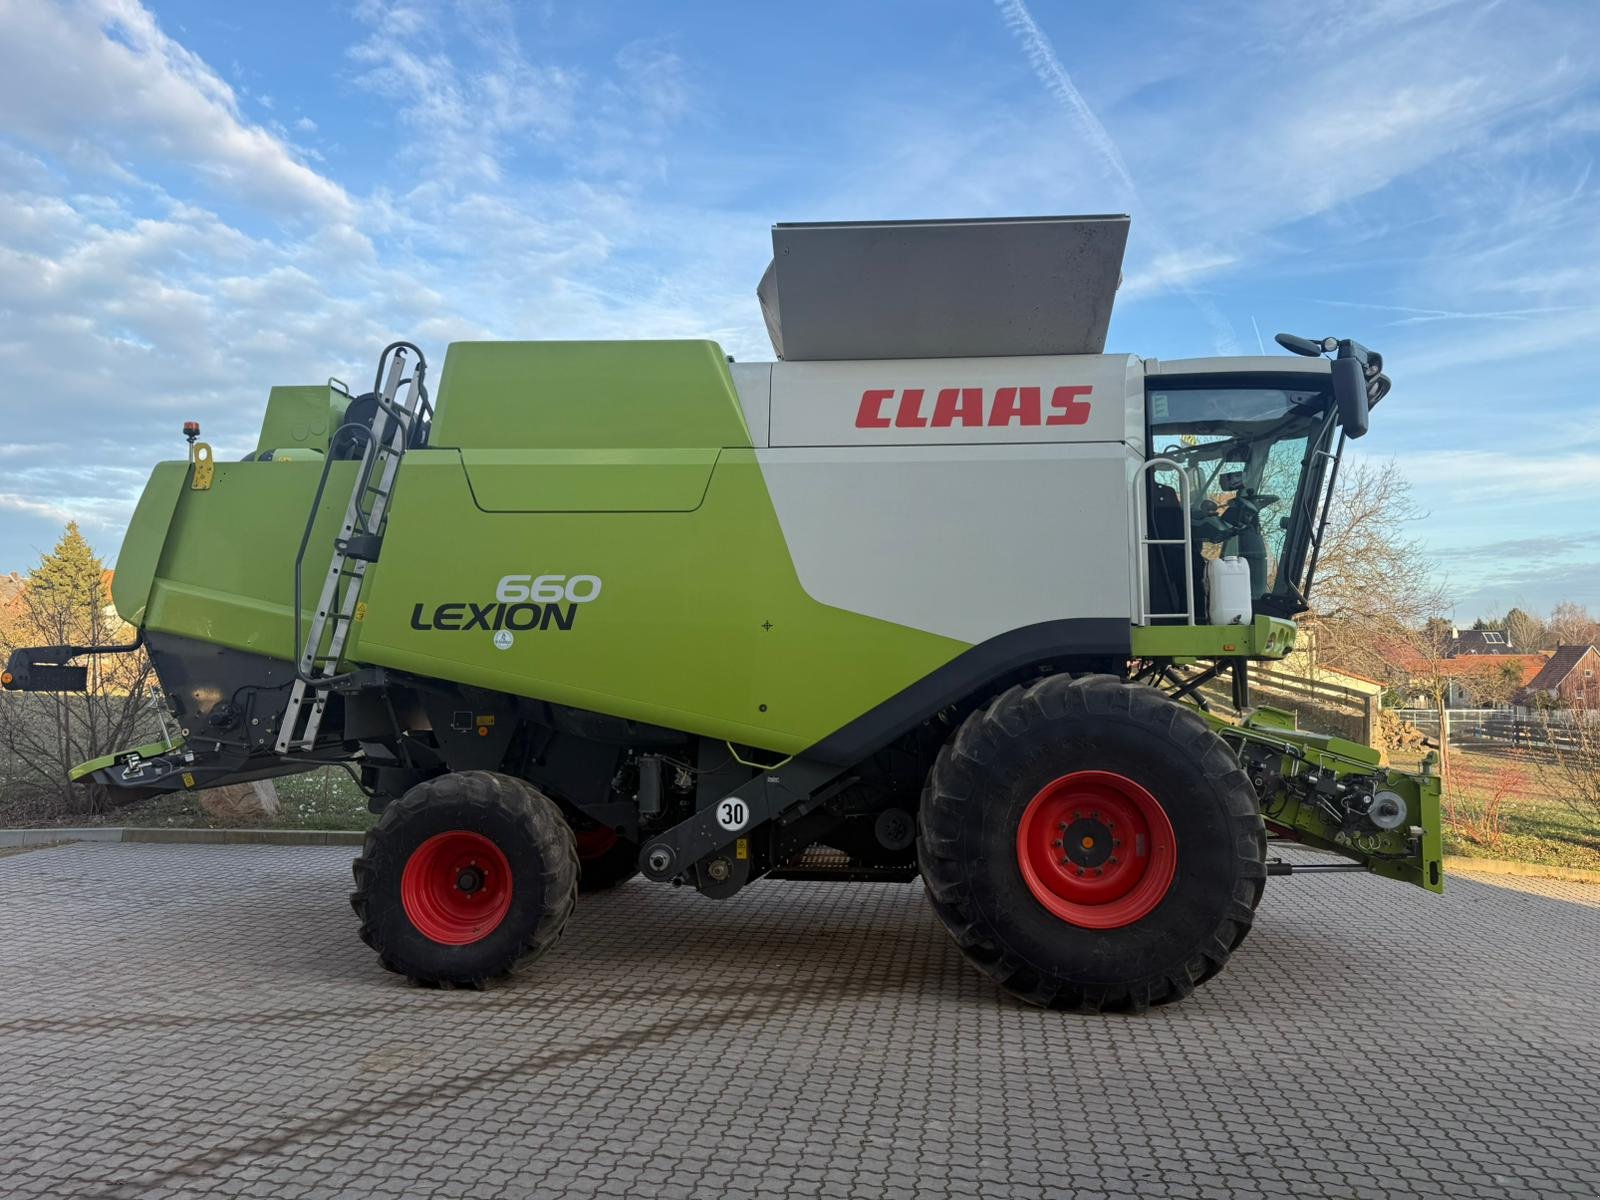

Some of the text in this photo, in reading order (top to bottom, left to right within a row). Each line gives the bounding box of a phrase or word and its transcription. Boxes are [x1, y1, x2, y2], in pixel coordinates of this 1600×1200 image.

[855, 385, 1093, 428] CLAAS
[496, 574, 602, 603] 660
[410, 603, 578, 631] LEXION
[721, 803, 744, 825] 30
